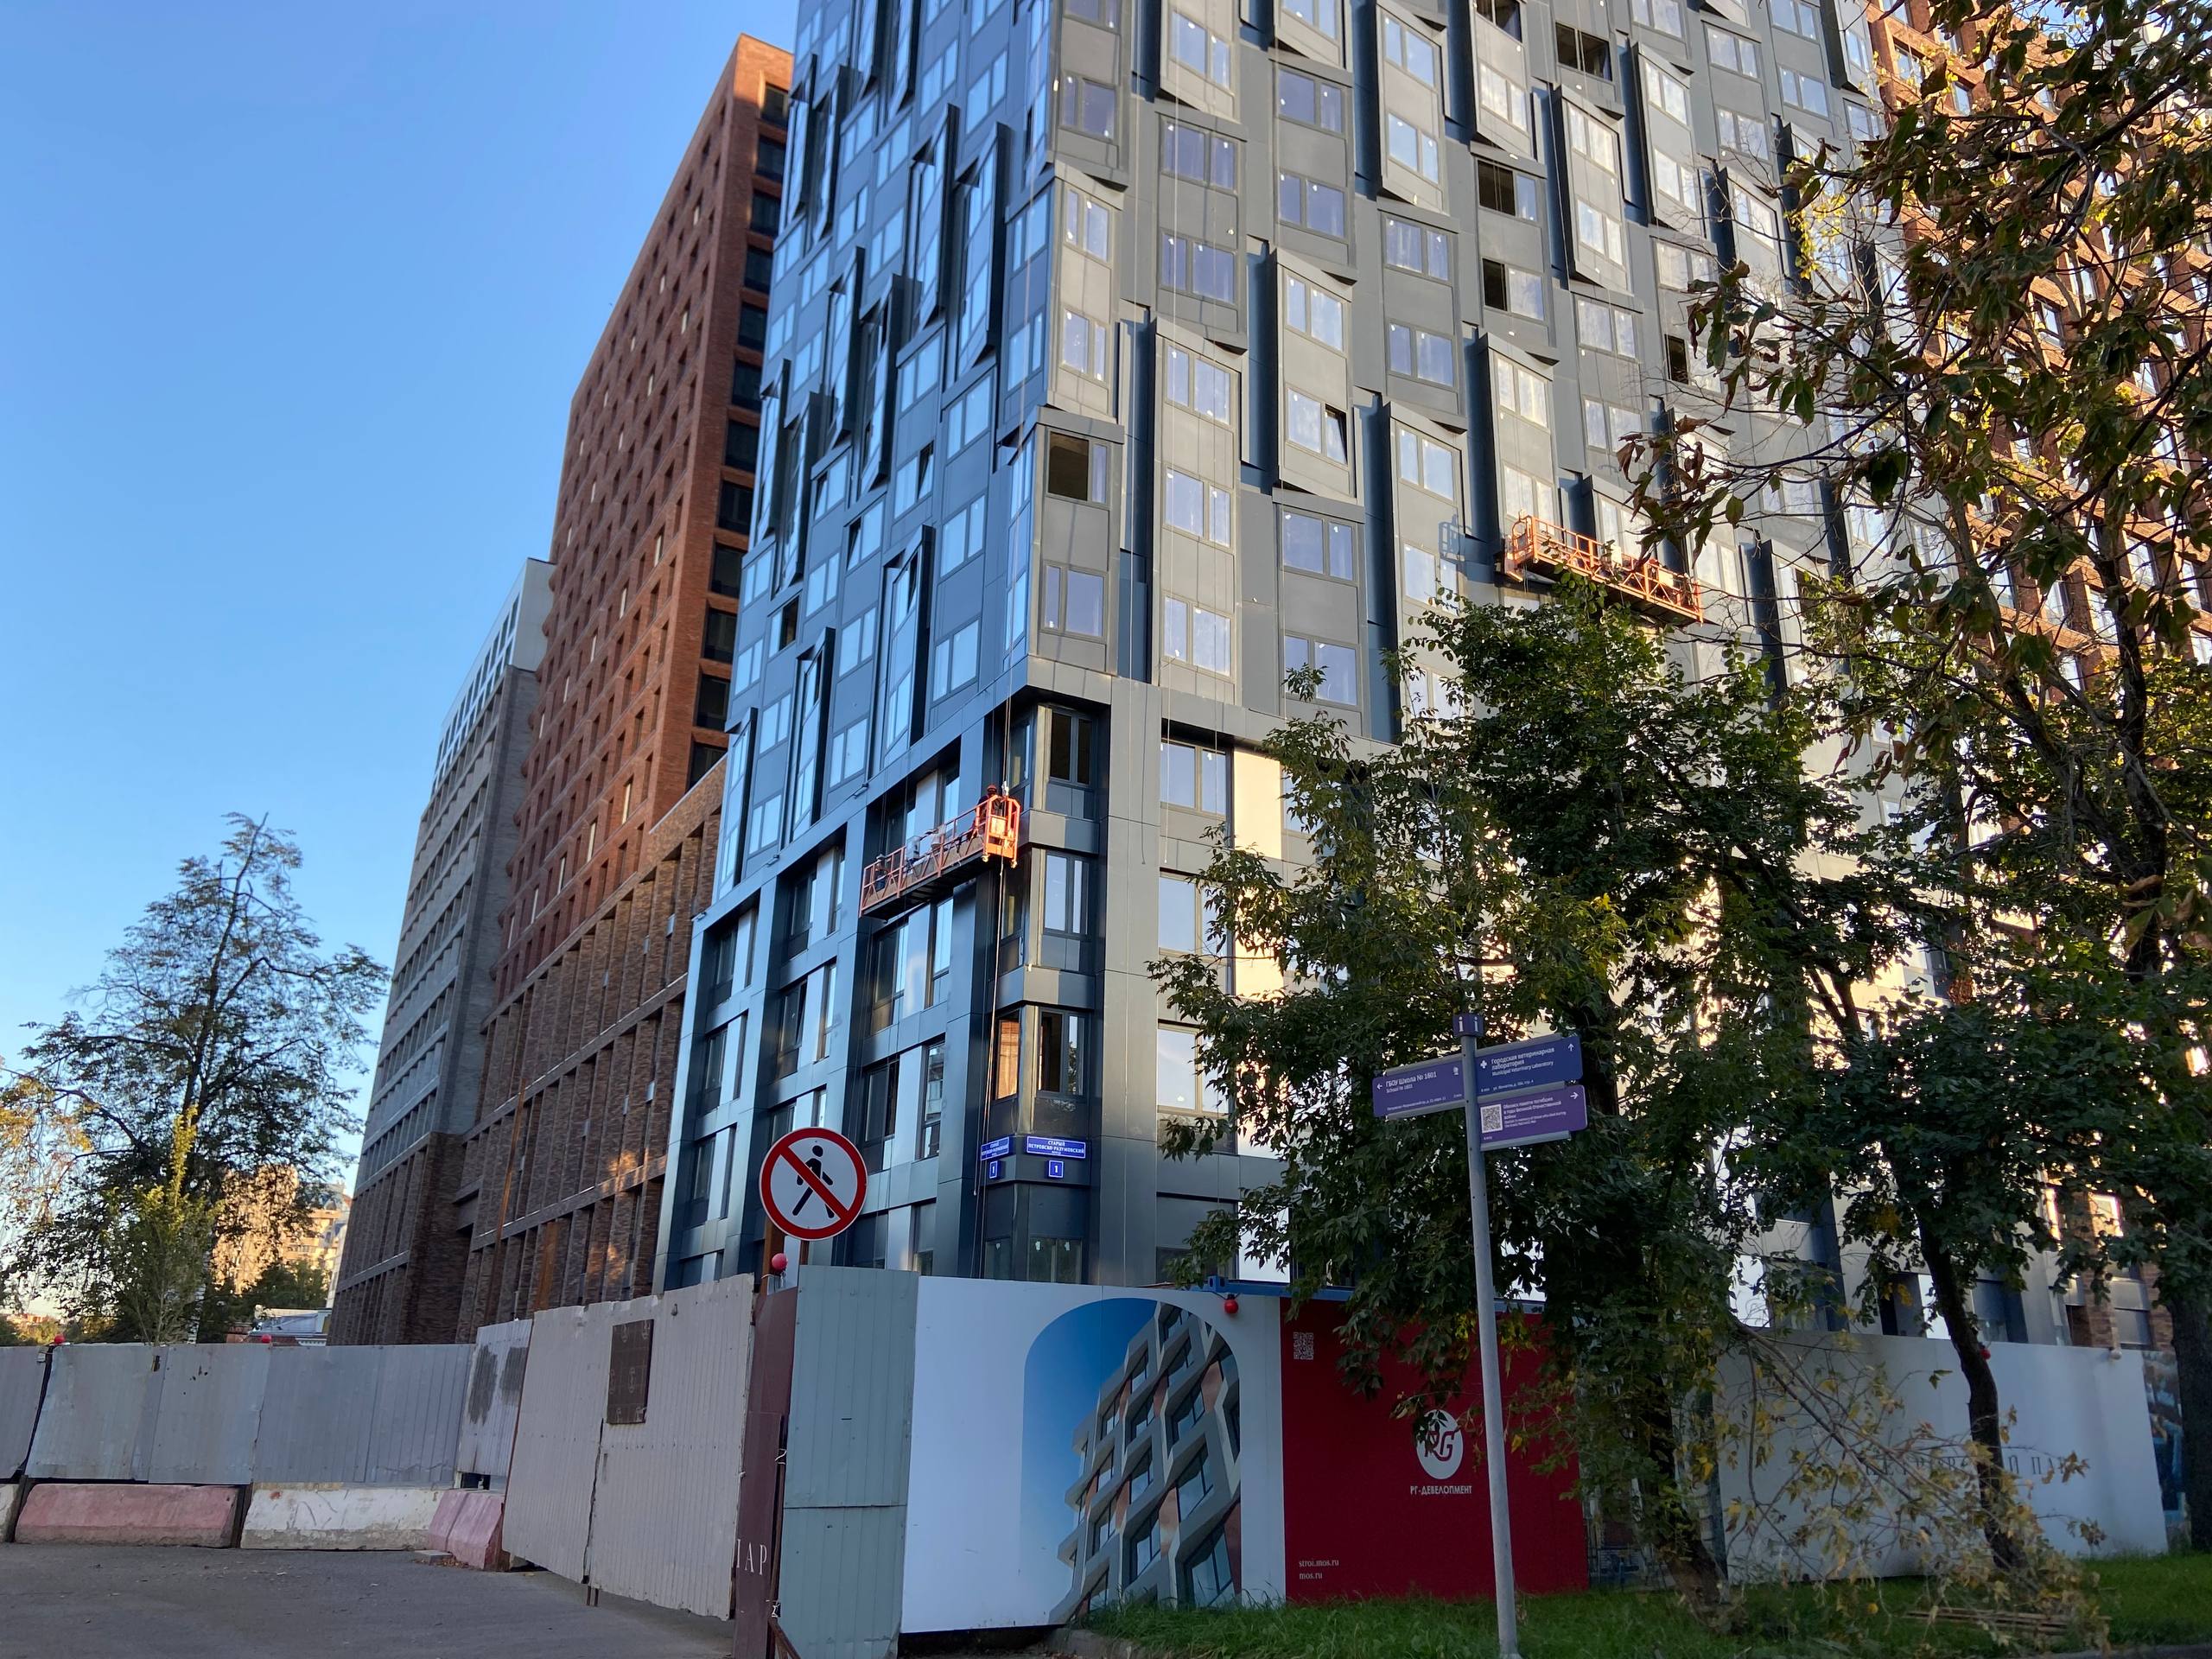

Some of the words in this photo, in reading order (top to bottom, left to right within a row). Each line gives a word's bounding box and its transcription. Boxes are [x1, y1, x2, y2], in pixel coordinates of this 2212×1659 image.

[1491, 1055, 1517, 1065] Городская
[1517, 1047, 1555, 1059] ветеринарная
[1491, 1059, 1525, 1071] лаборатория
[1299, 1559, 1339, 1567] stroi.mos.ru
[1299, 1572, 1323, 1580] mos.ru
